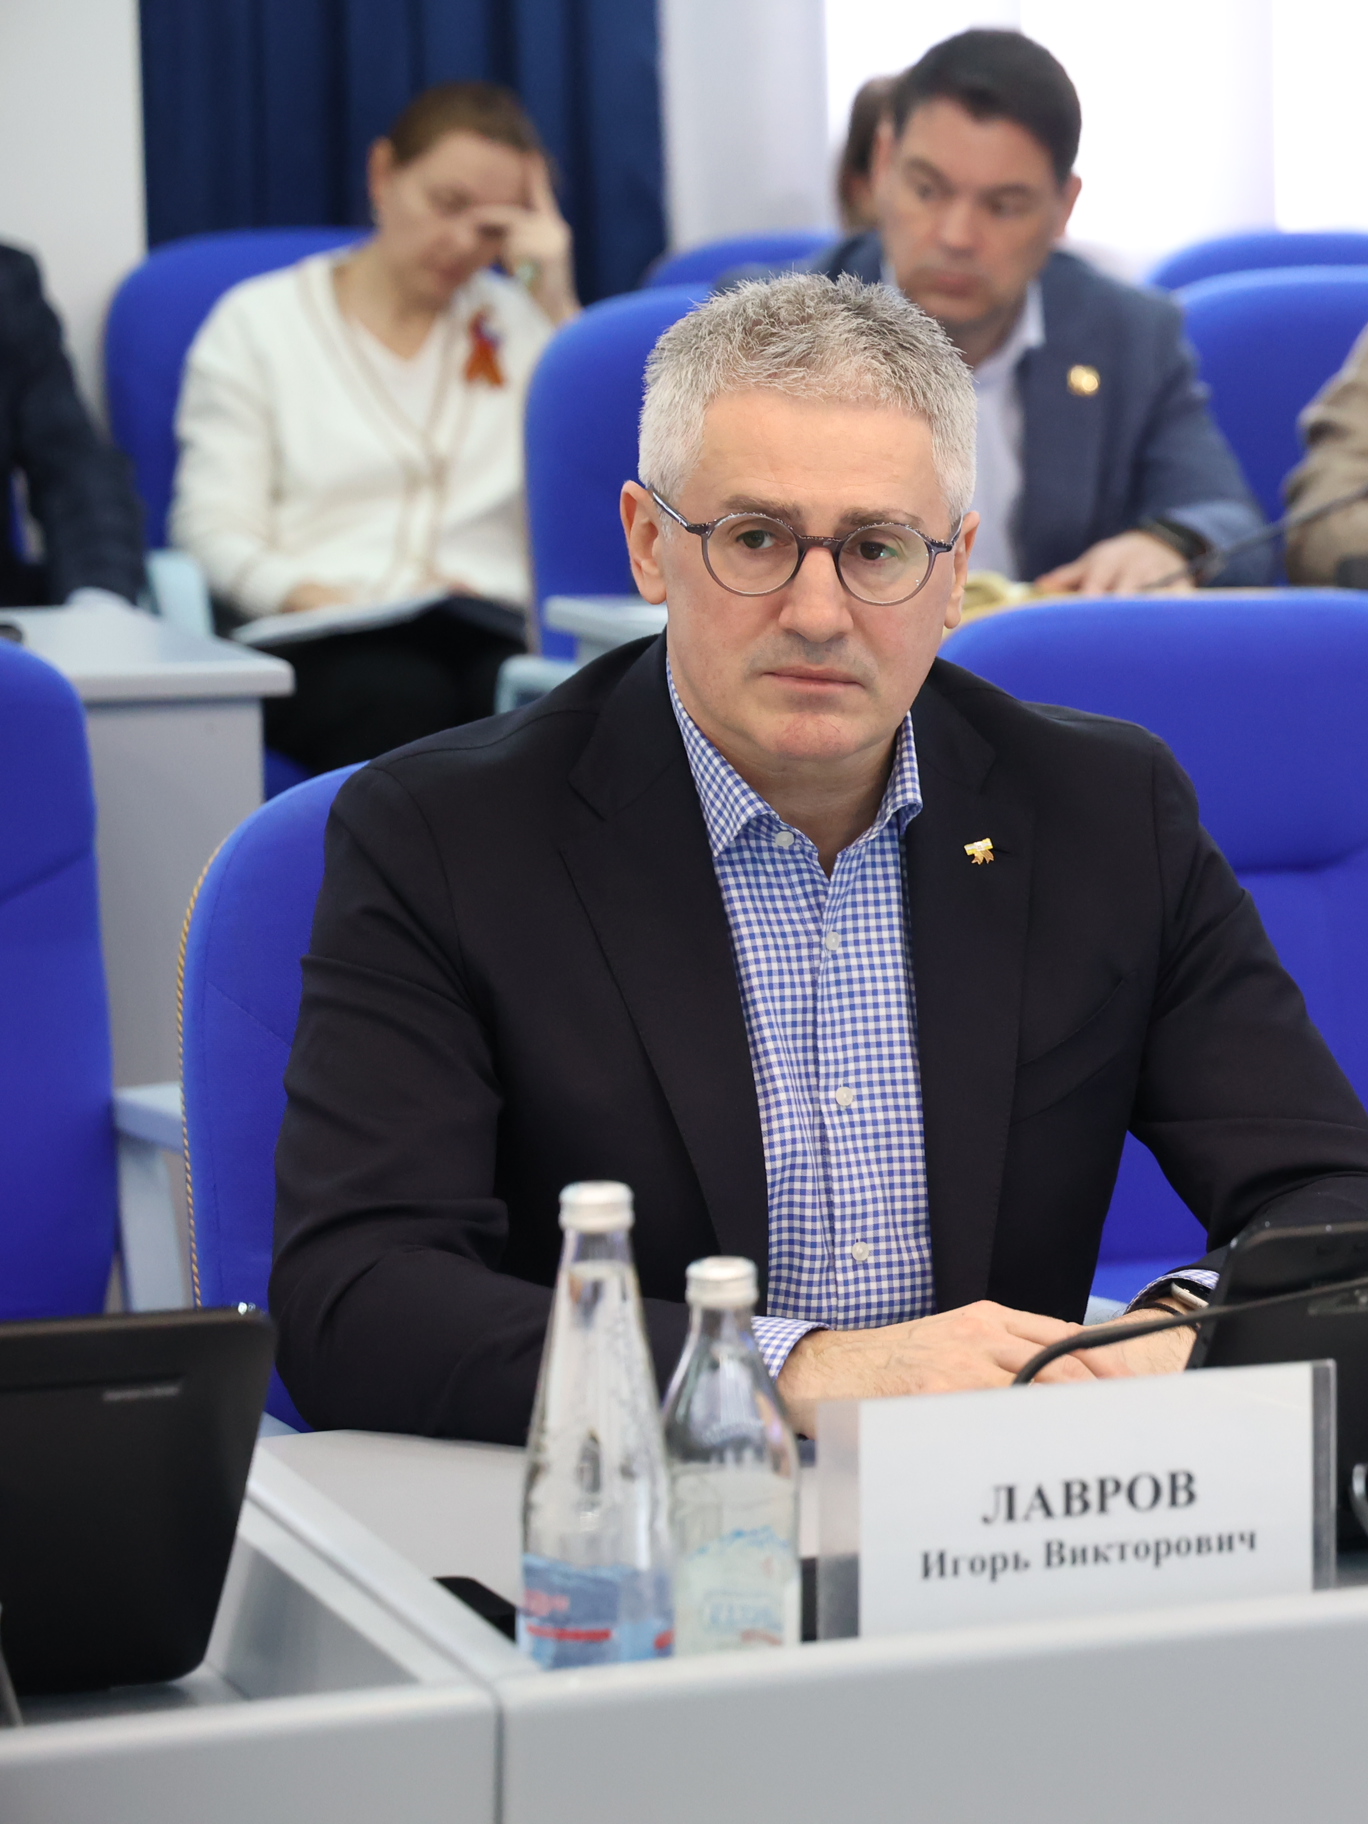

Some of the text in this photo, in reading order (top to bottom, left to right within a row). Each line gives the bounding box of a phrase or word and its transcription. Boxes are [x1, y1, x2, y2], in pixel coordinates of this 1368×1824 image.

[982, 1470, 1197, 1525] ЛАВРОВ
[921, 1531, 1257, 1582] Игорь Викторович
